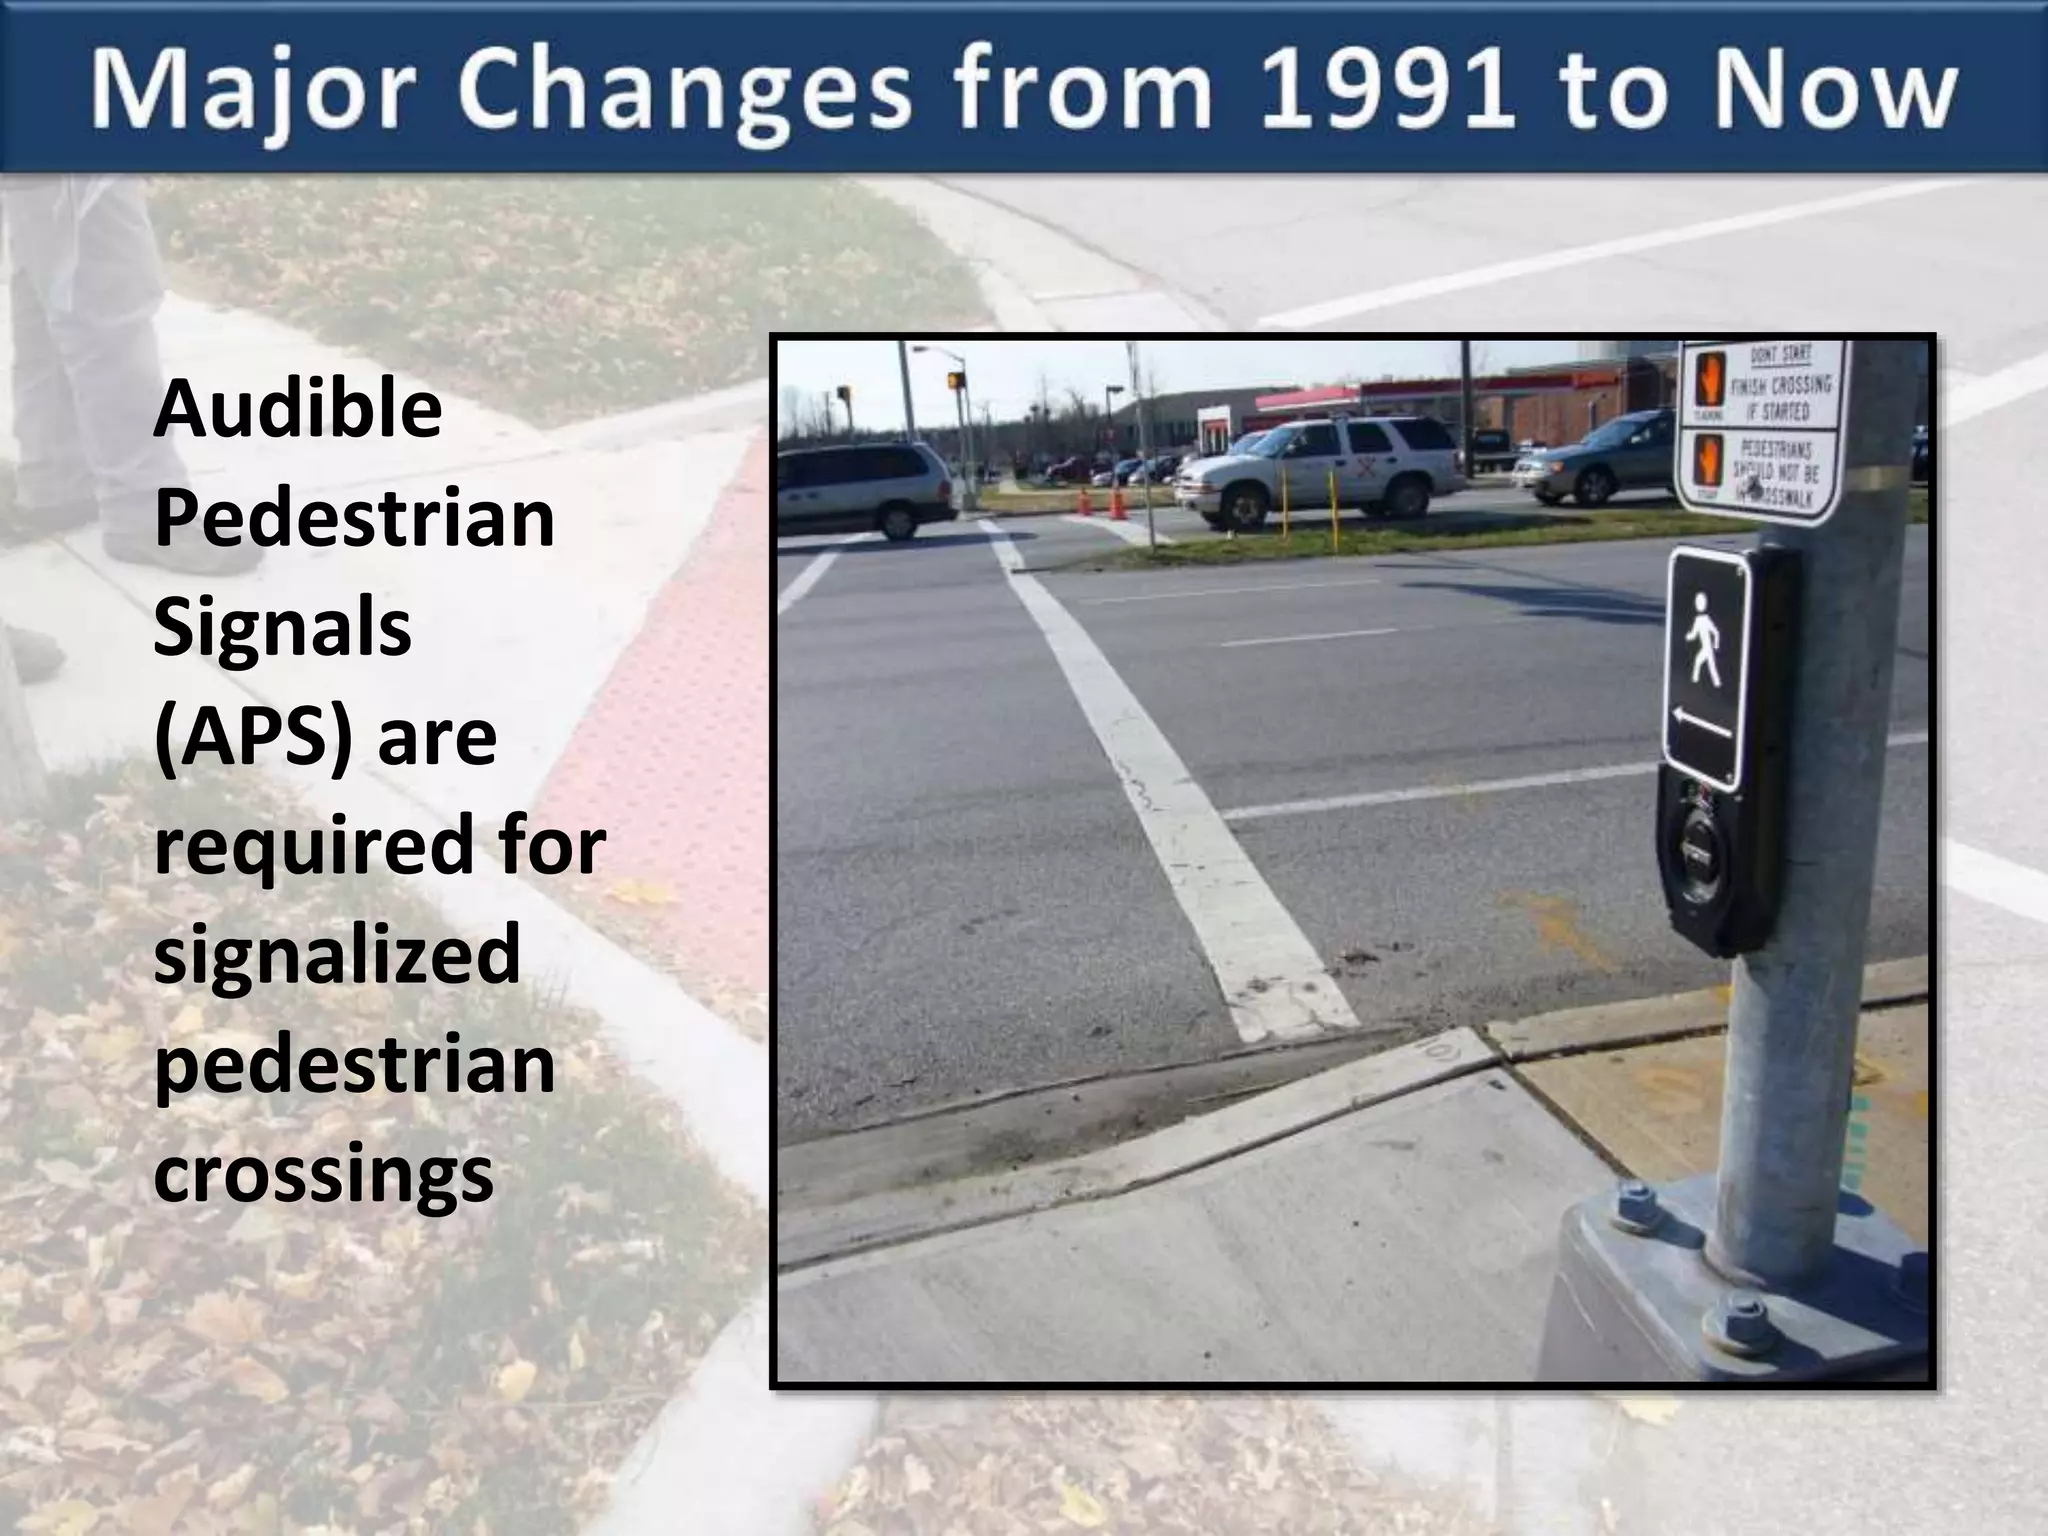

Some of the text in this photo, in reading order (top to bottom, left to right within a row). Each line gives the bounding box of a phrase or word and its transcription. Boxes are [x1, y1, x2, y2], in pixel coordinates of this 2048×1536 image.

[1731, 374, 1833, 396] FINISH CROSSING
[1763, 401, 1810, 421] STARTED
[1741, 439, 1812, 460] PEDESTRIANS
[1805, 464, 1820, 484] BE
